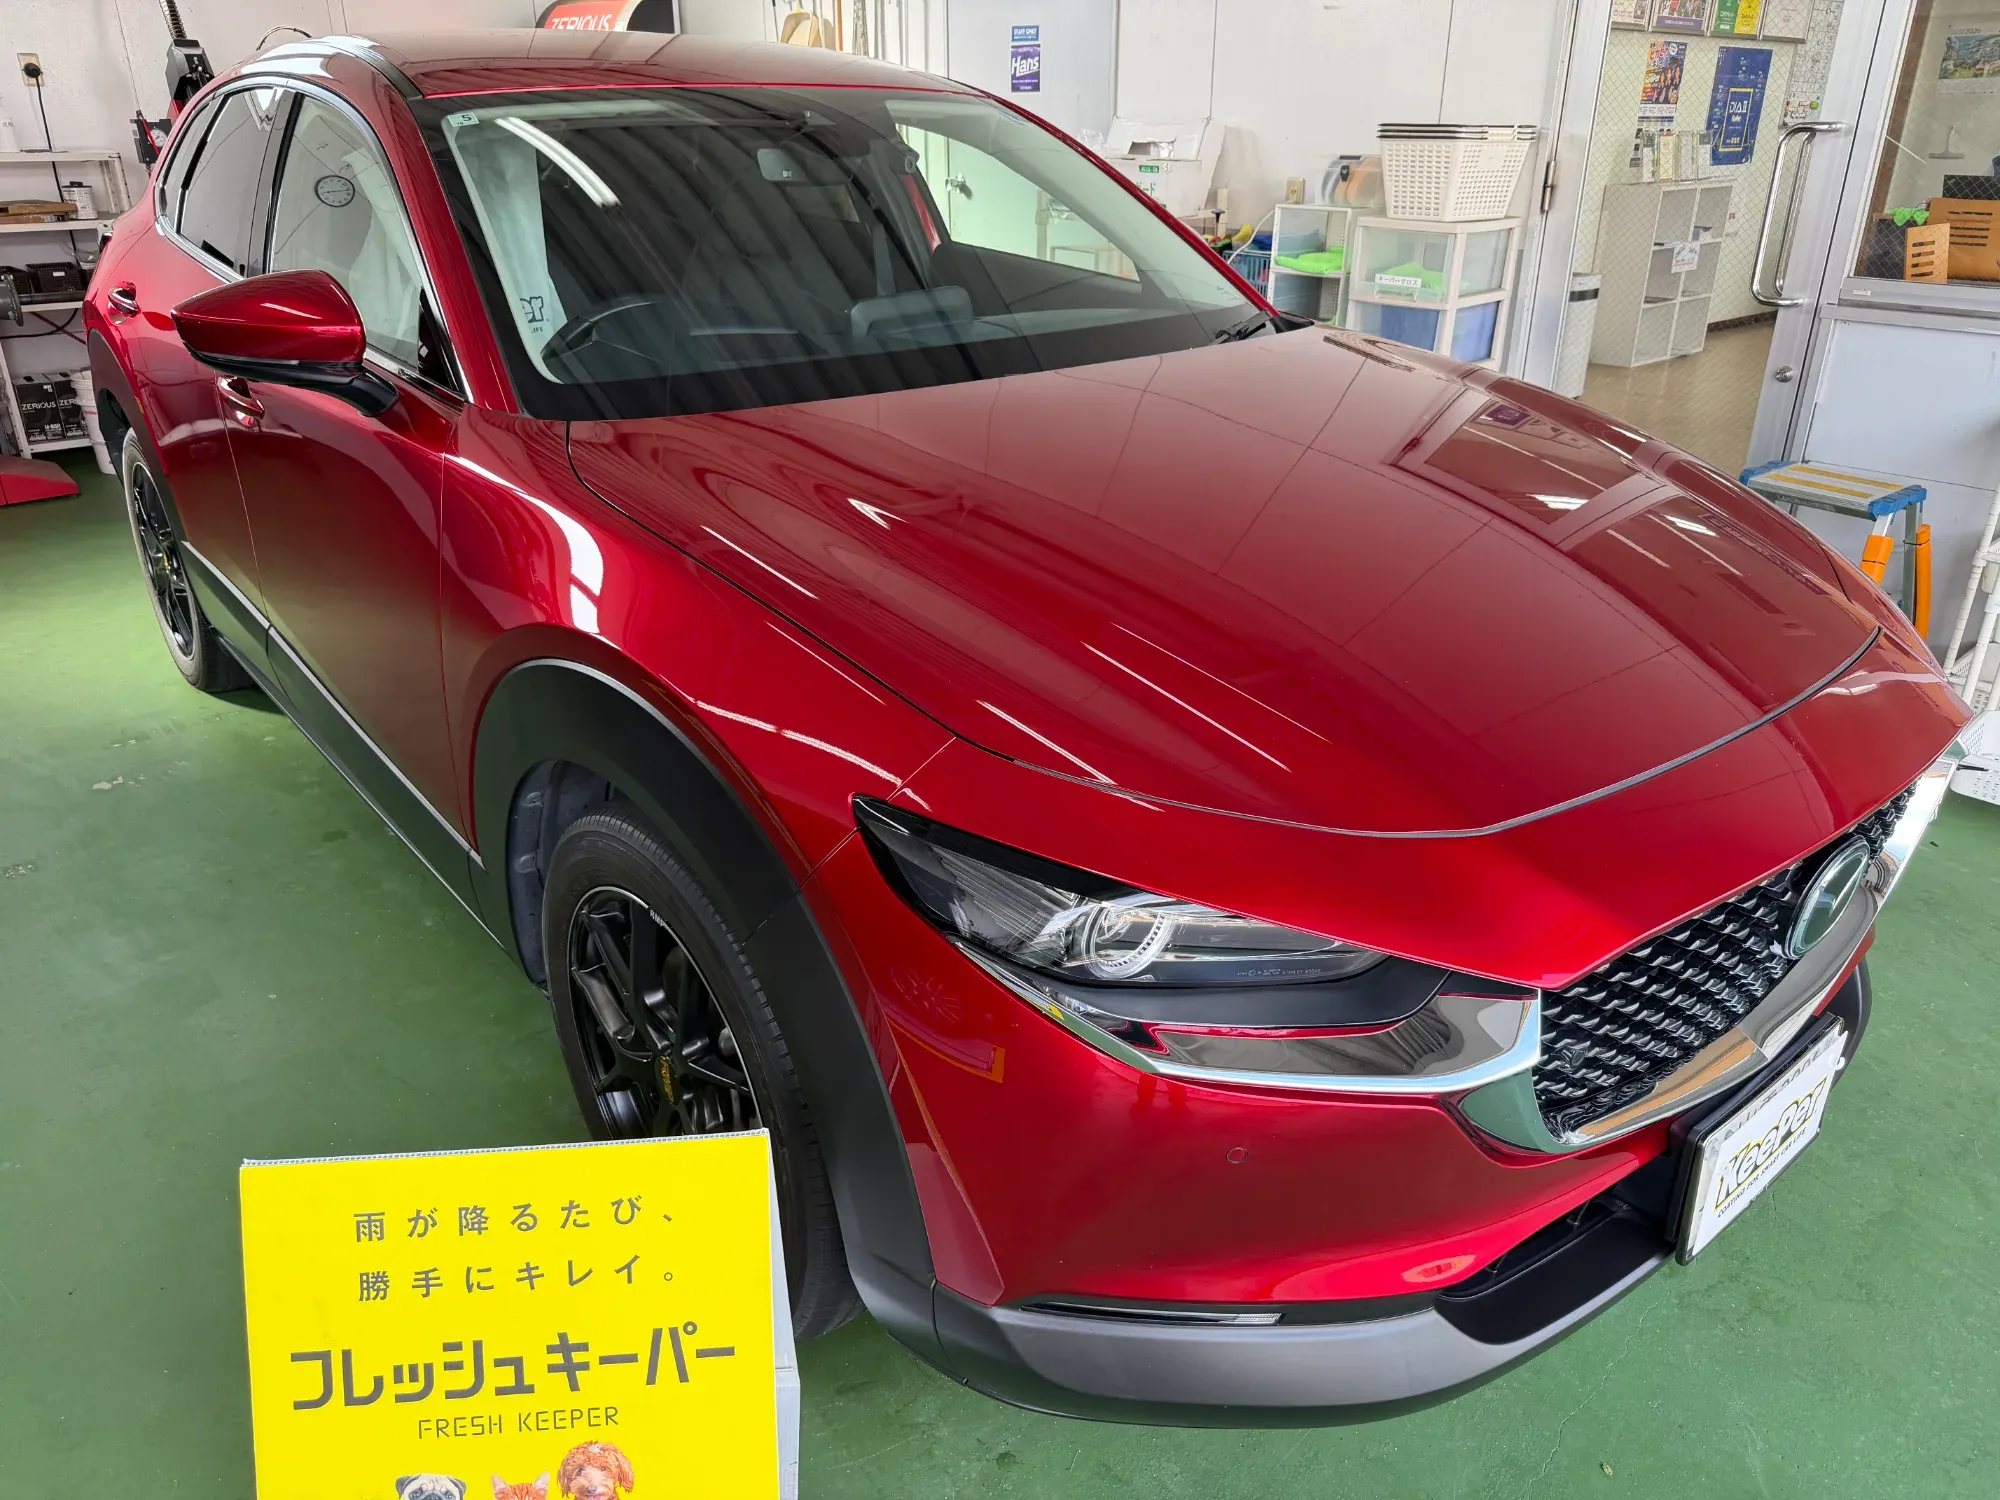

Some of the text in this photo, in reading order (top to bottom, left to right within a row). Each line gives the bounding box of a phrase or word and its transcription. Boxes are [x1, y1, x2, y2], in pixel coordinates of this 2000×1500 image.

[1011, 56, 1040, 77] Hans
[461, 114, 472, 122] 5
[22, 401, 56, 411] ZERIOUS
[60, 398, 76, 406] ZER
[1717, 1186, 1745, 1218] COATING
[1746, 1174, 1760, 1190] FOR
[1761, 1154, 1782, 1176] SMART
[354, 1195, 672, 1242] 雨が降るたび、
[359, 1255, 673, 1302] 勝手にキレイ。
[291, 1321, 735, 1410] フレッシュキーパー
[419, 1407, 618, 1439] FRESH KEEPER
